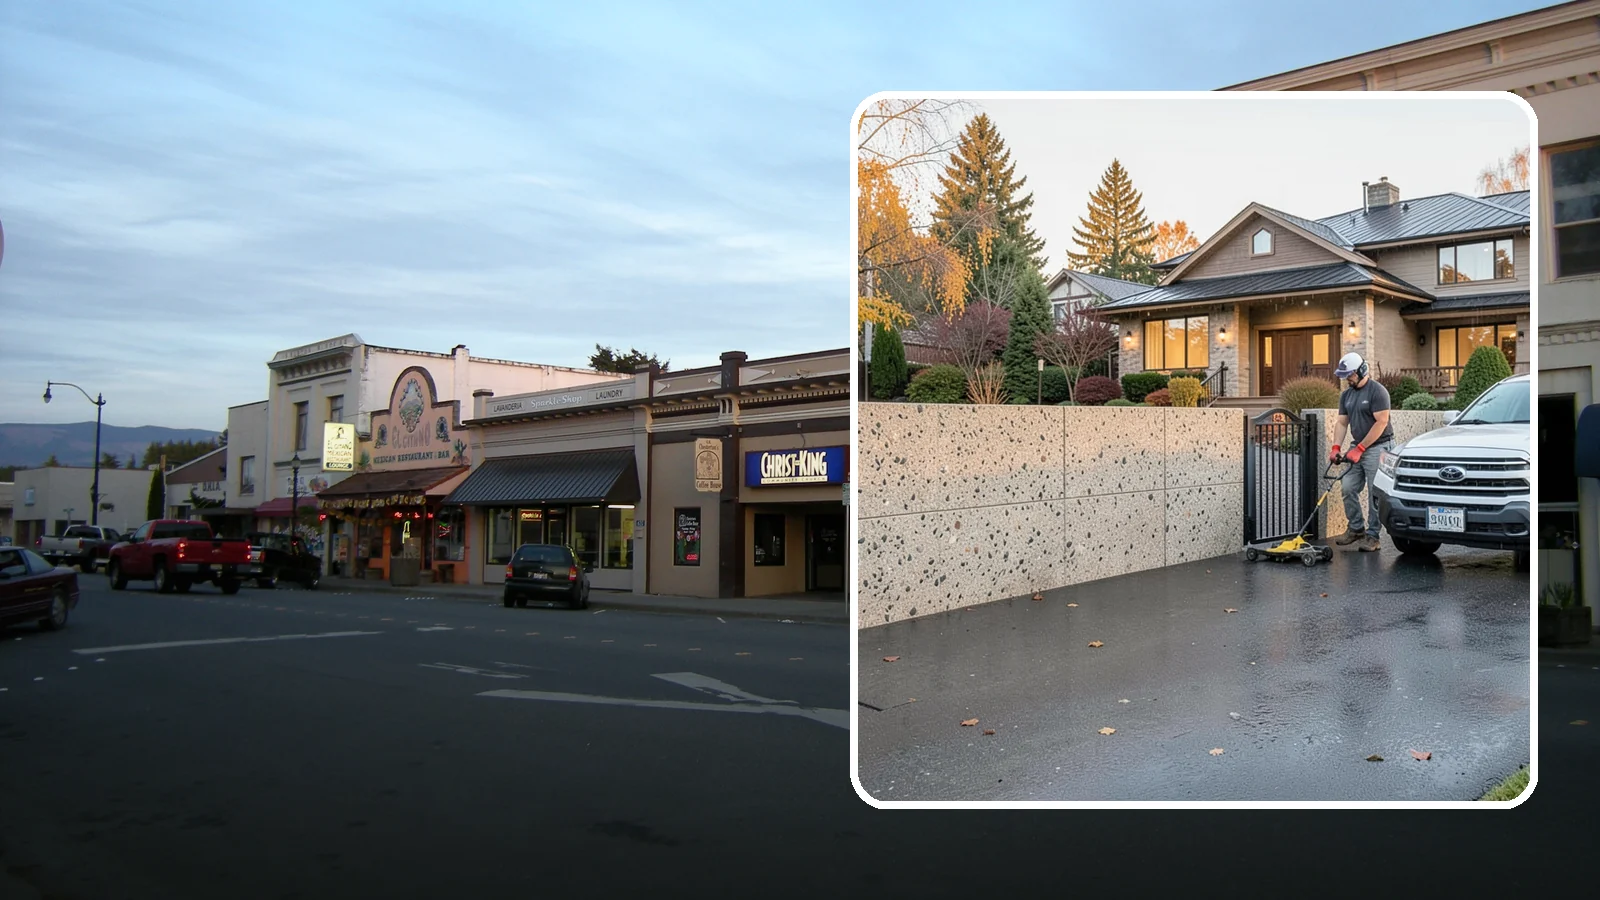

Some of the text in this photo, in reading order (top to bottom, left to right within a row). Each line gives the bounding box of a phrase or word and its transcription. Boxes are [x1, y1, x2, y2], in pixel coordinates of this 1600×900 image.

[562, 394, 582, 404] Shop
[595, 389, 623, 400] LAUNDRY
[493, 402, 522, 412] LAVANDERIA
[374, 450, 450, 464] MEXICAN RESTAURANT BAR
[761, 450, 827, 478] CHRIST KING
